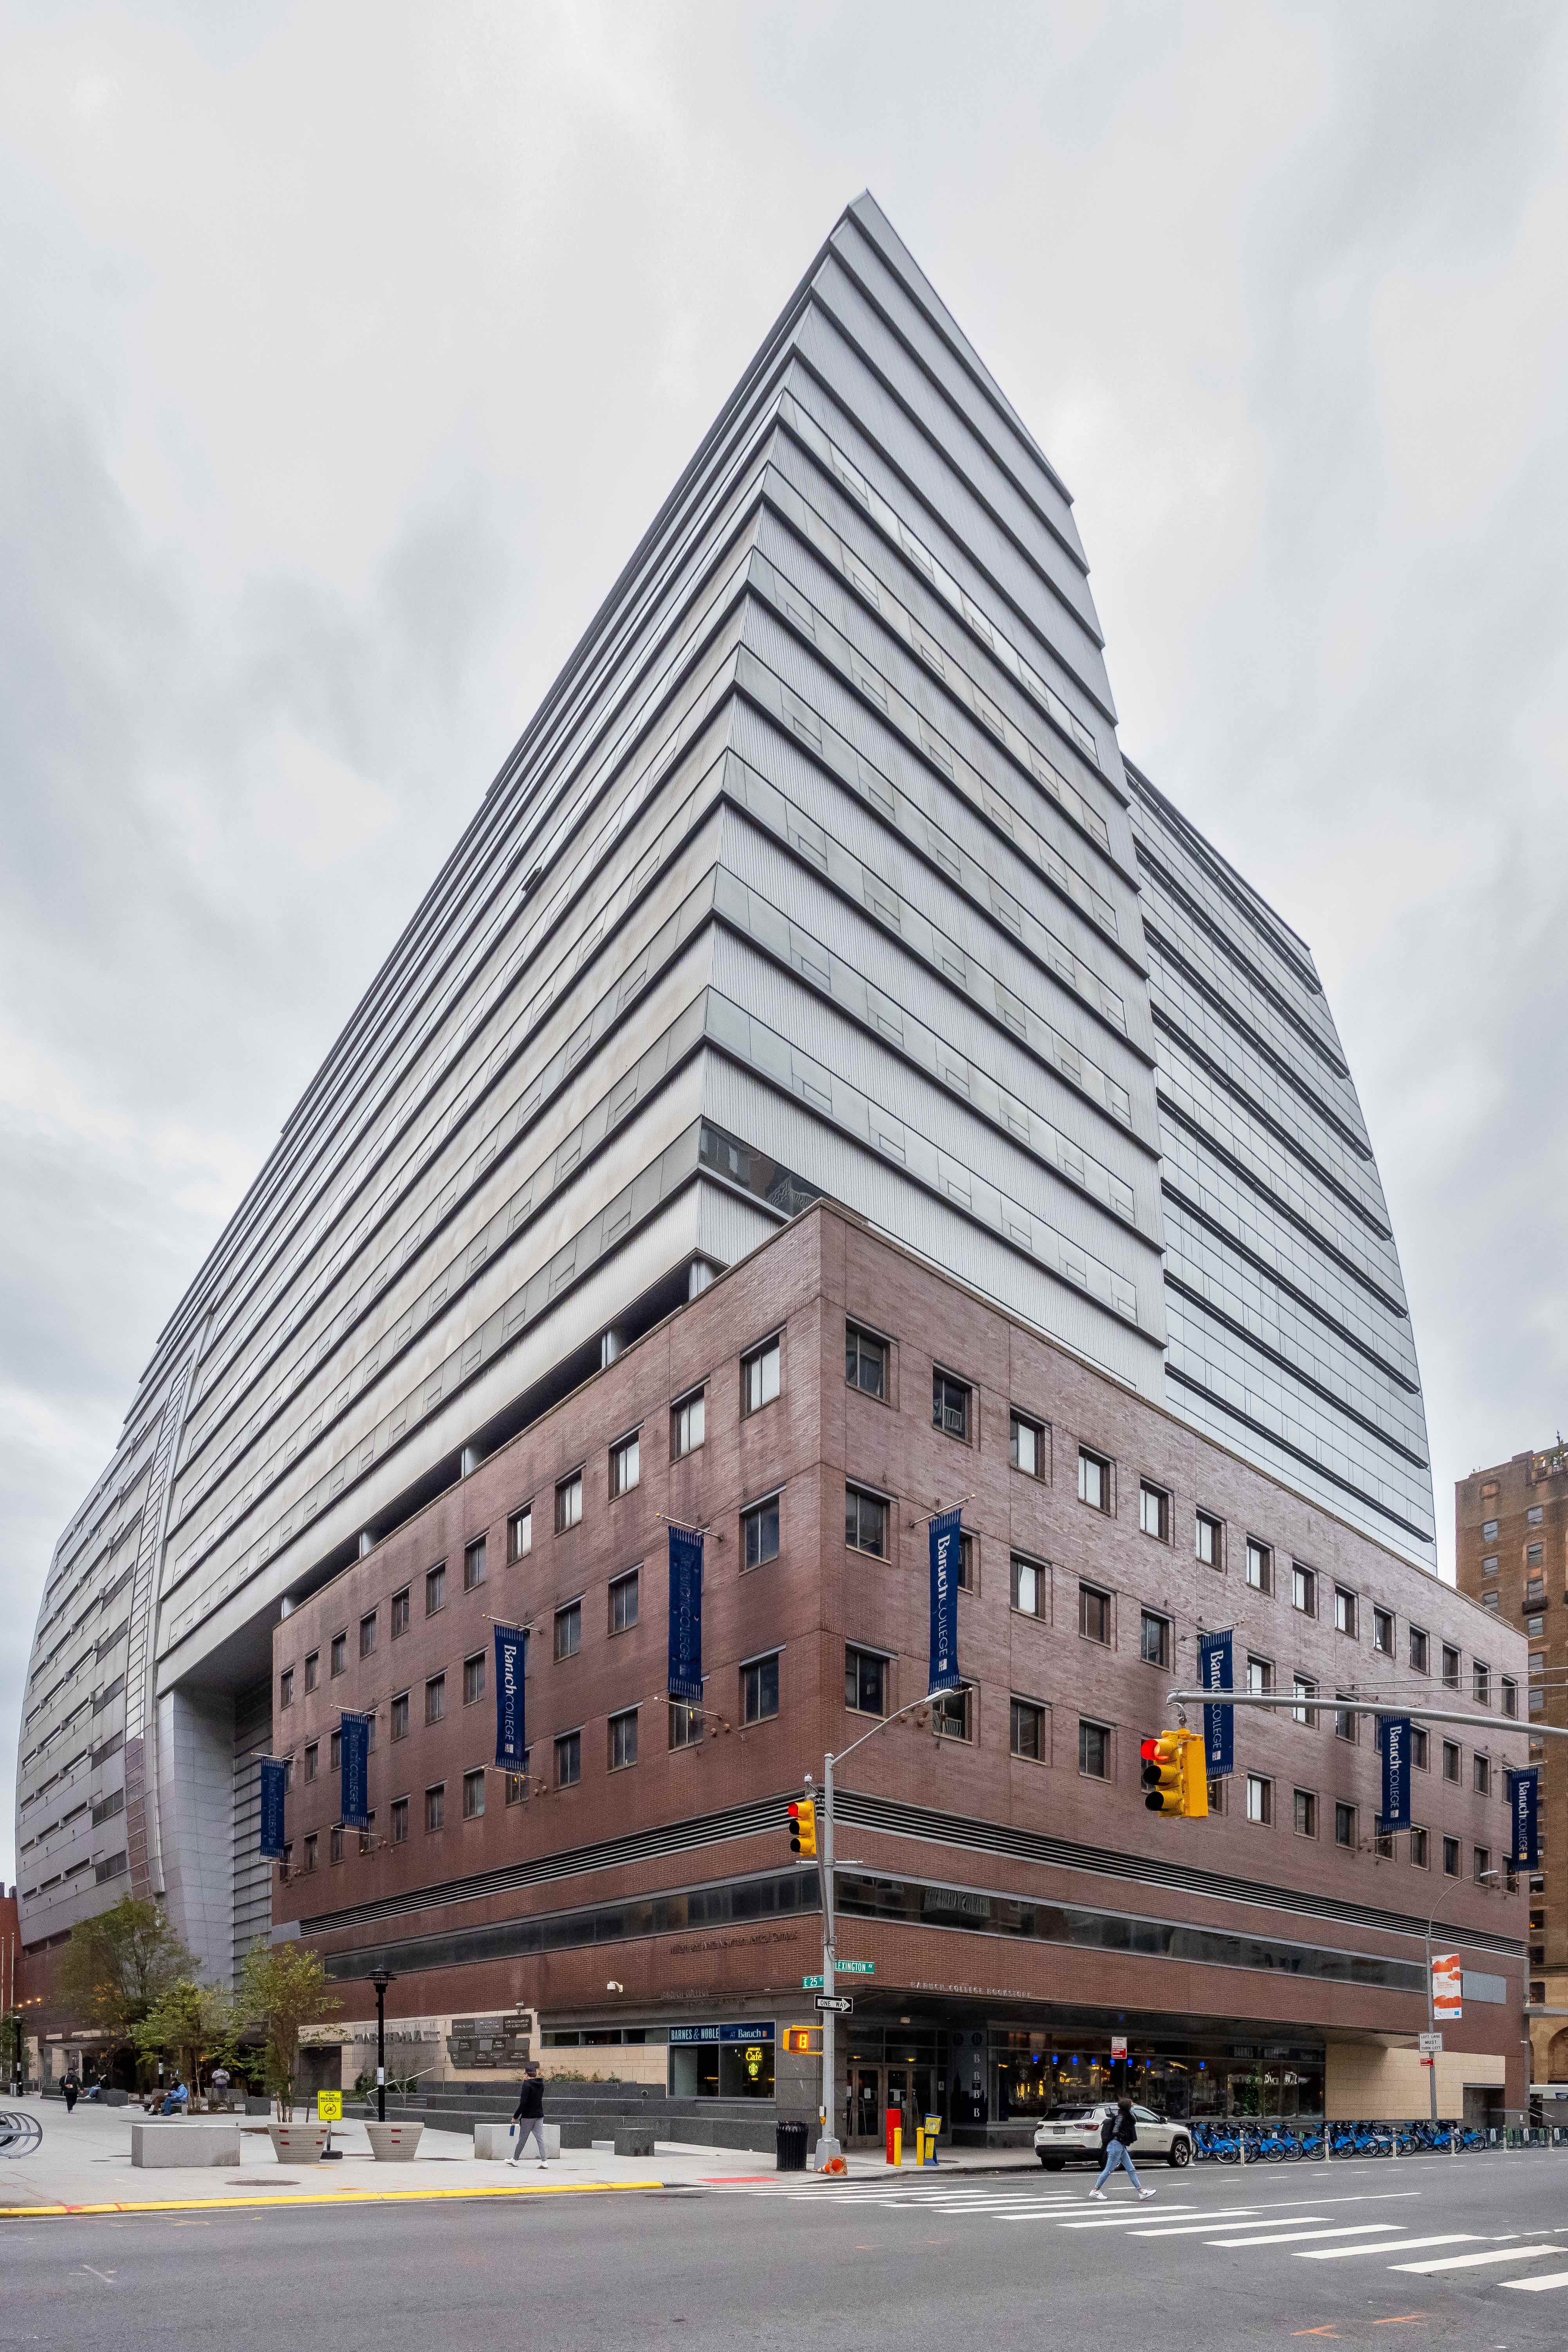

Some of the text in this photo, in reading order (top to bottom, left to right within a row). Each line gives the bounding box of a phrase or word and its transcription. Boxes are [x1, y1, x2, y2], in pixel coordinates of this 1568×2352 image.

[835, 1961, 866, 1972] LEXINGTON
[804, 1978, 808, 1986] E
[810, 1978, 817, 1986] 25
[949, 1985, 983, 1994] COLLEGE
[671, 2029, 693, 2040] BARNES
[693, 2028, 700, 2040] &
[701, 2027, 720, 2039] NOBLE
[738, 2028, 761, 2038] Baruch
[745, 2051, 762, 2061] Café
[974, 2108, 980, 2117] B
